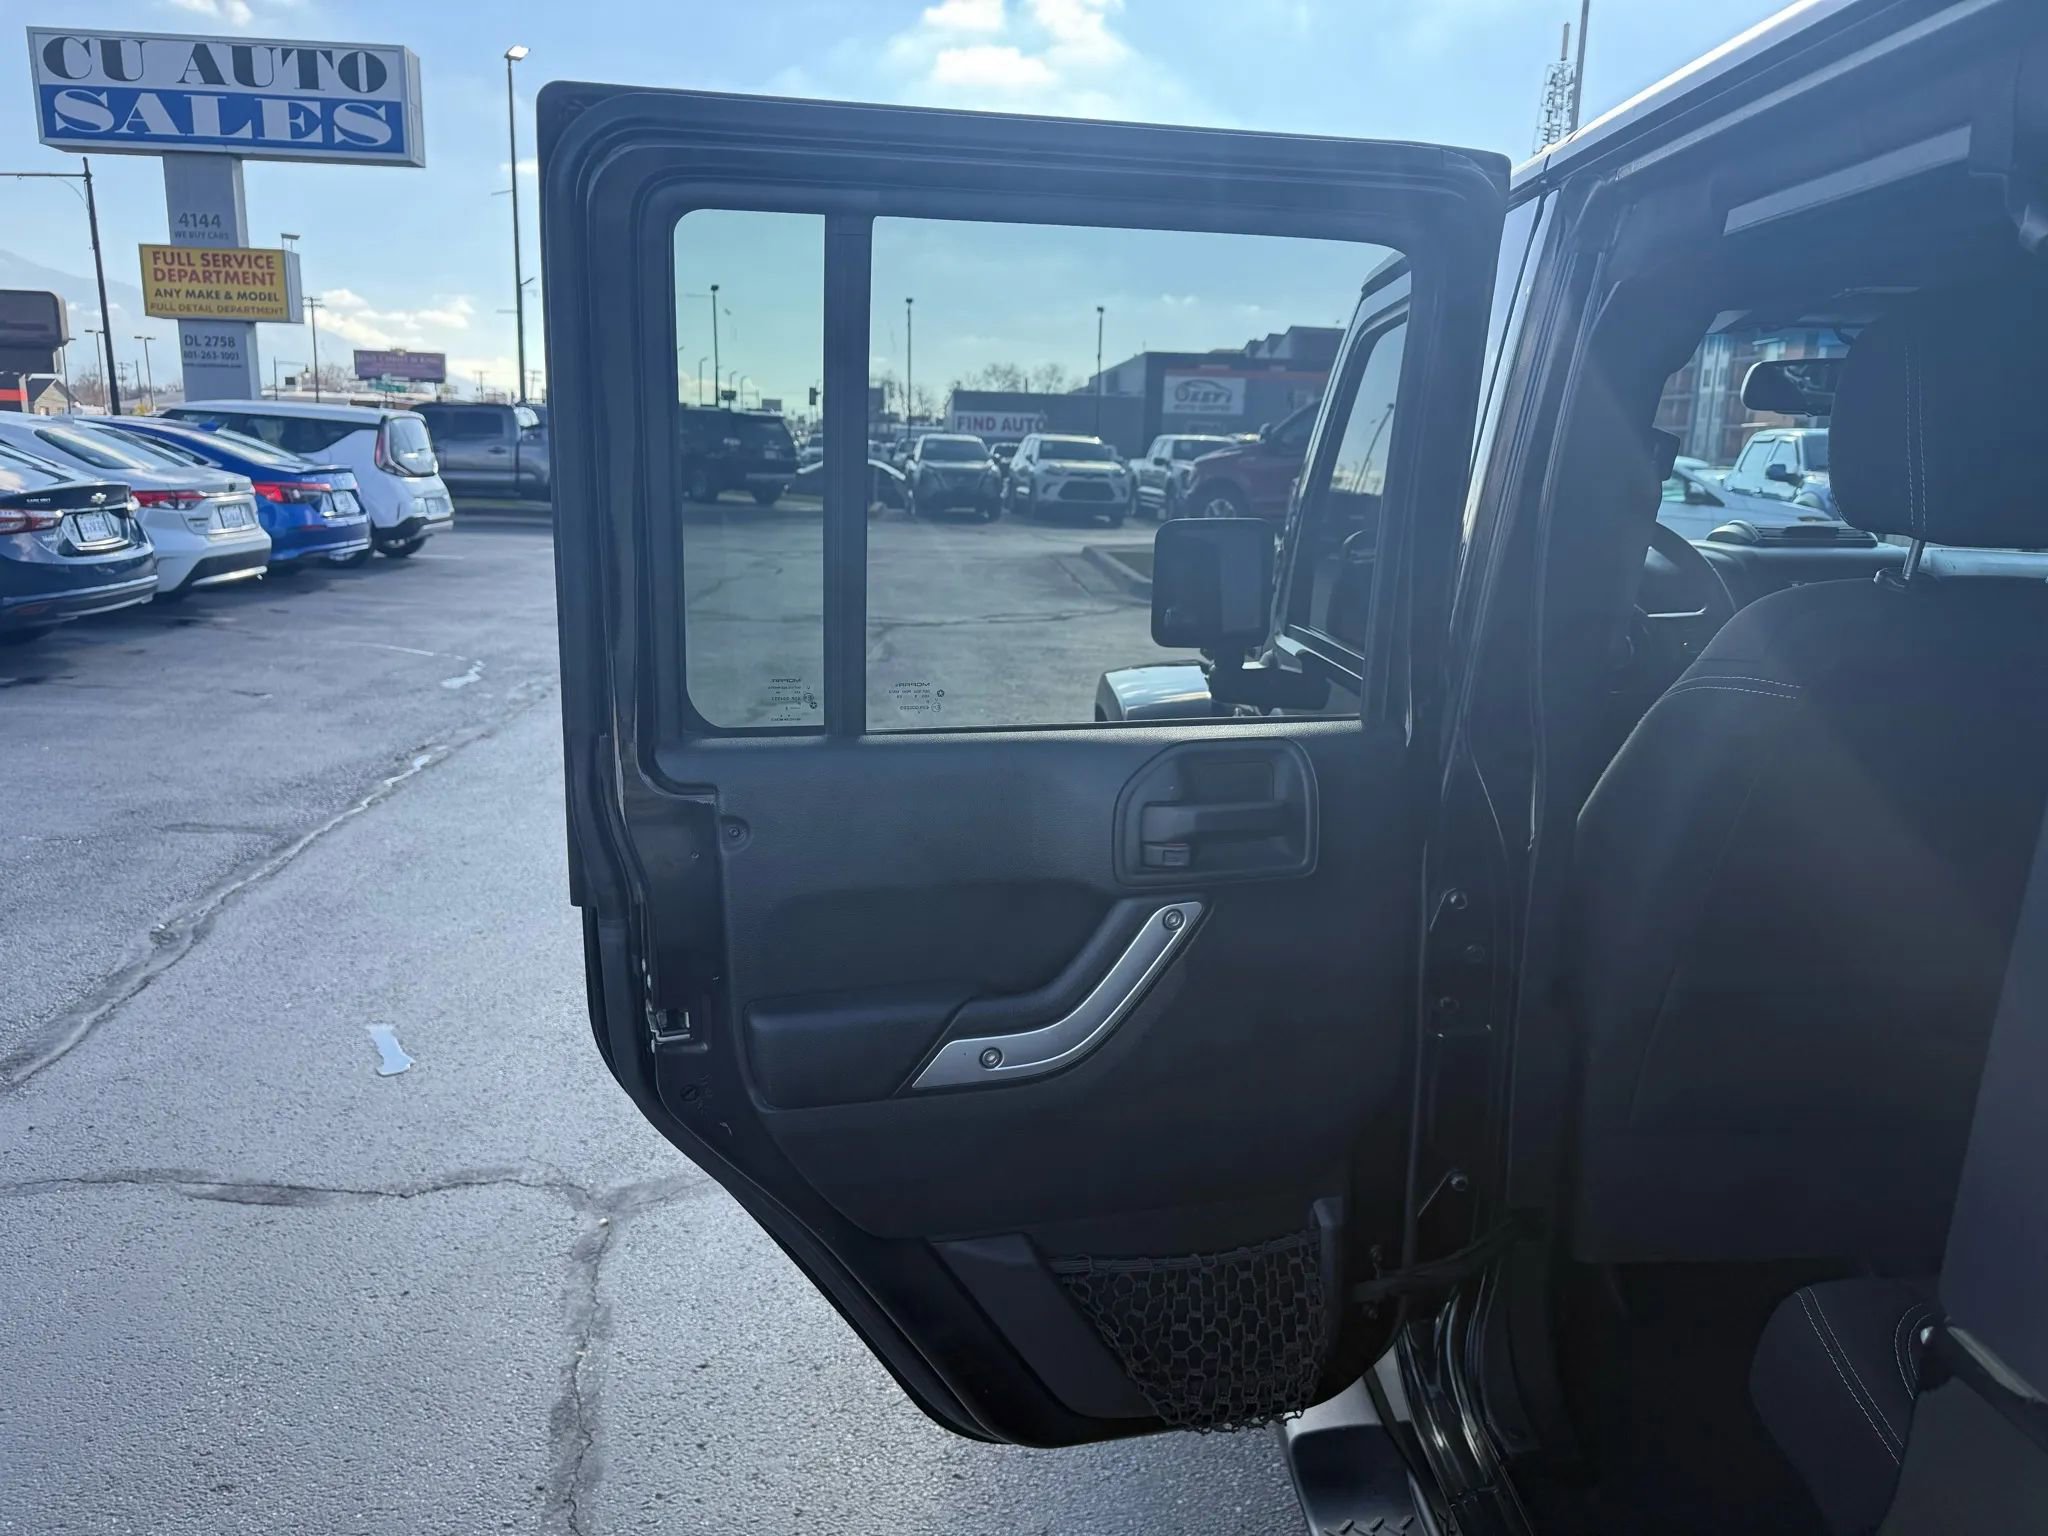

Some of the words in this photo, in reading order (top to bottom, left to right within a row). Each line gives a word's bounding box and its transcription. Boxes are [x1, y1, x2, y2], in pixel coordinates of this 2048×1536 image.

[42, 36, 145, 82] CU
[176, 42, 388, 94] AUTO
[53, 89, 393, 147] SALES
[178, 212, 221, 228] 4144
[175, 230, 187, 239] WE
[188, 231, 206, 240] BUY
[207, 231, 230, 241] CARS
[152, 251, 196, 267] FULL
[201, 253, 275, 269] SERVICE
[153, 268, 276, 286] DEPARTMENT
[154, 288, 181, 299] ANY
[185, 289, 220, 300] MAKE
[224, 291, 233, 300] &
[236, 291, 280, 302] MODEL
[150, 302, 176, 311] FULL
[178, 303, 214, 313] DETAIL
[216, 305, 284, 315] DEPARTMENT
[184, 335, 201, 347] DL
[204, 335, 236, 348] 2758
[957, 415, 997, 431] FIND
[1001, 416, 1045, 432] AUTO
